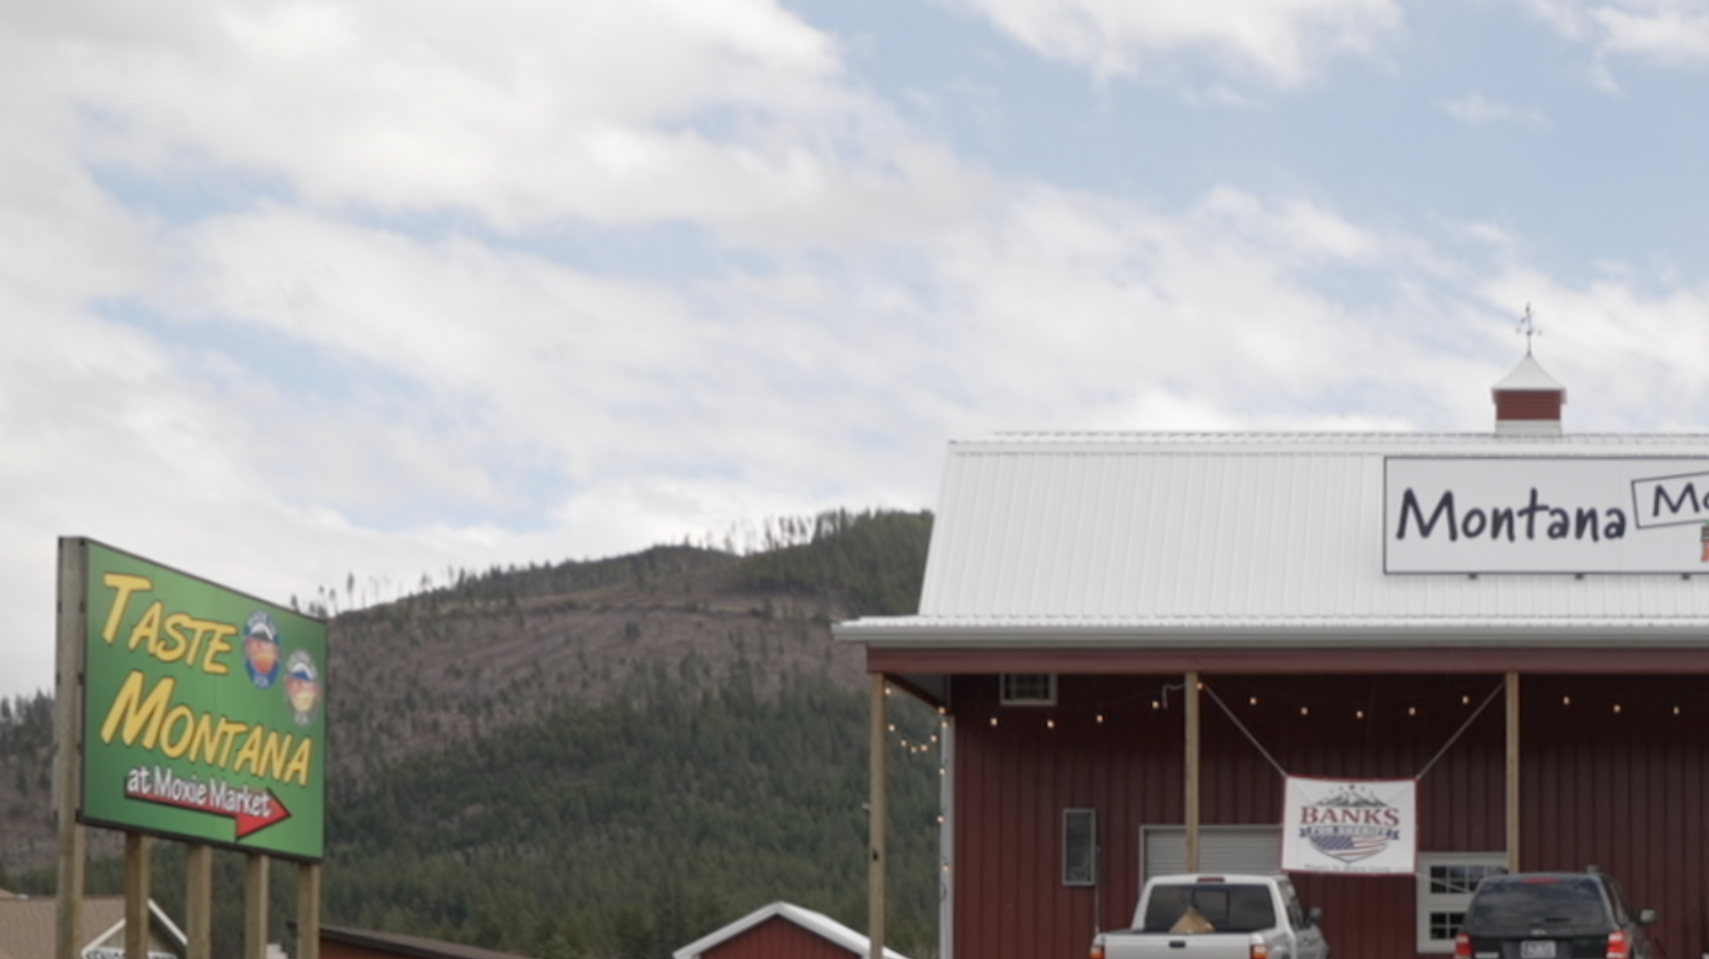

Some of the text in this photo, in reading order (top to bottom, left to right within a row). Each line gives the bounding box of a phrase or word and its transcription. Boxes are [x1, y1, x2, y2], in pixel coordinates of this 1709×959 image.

[1396, 487, 1627, 543] Montana
[102, 572, 238, 675] TASTE
[100, 669, 313, 787] MONTANA
[126, 764, 273, 819] at Moxie Market
[1300, 805, 1401, 828] BANKS
